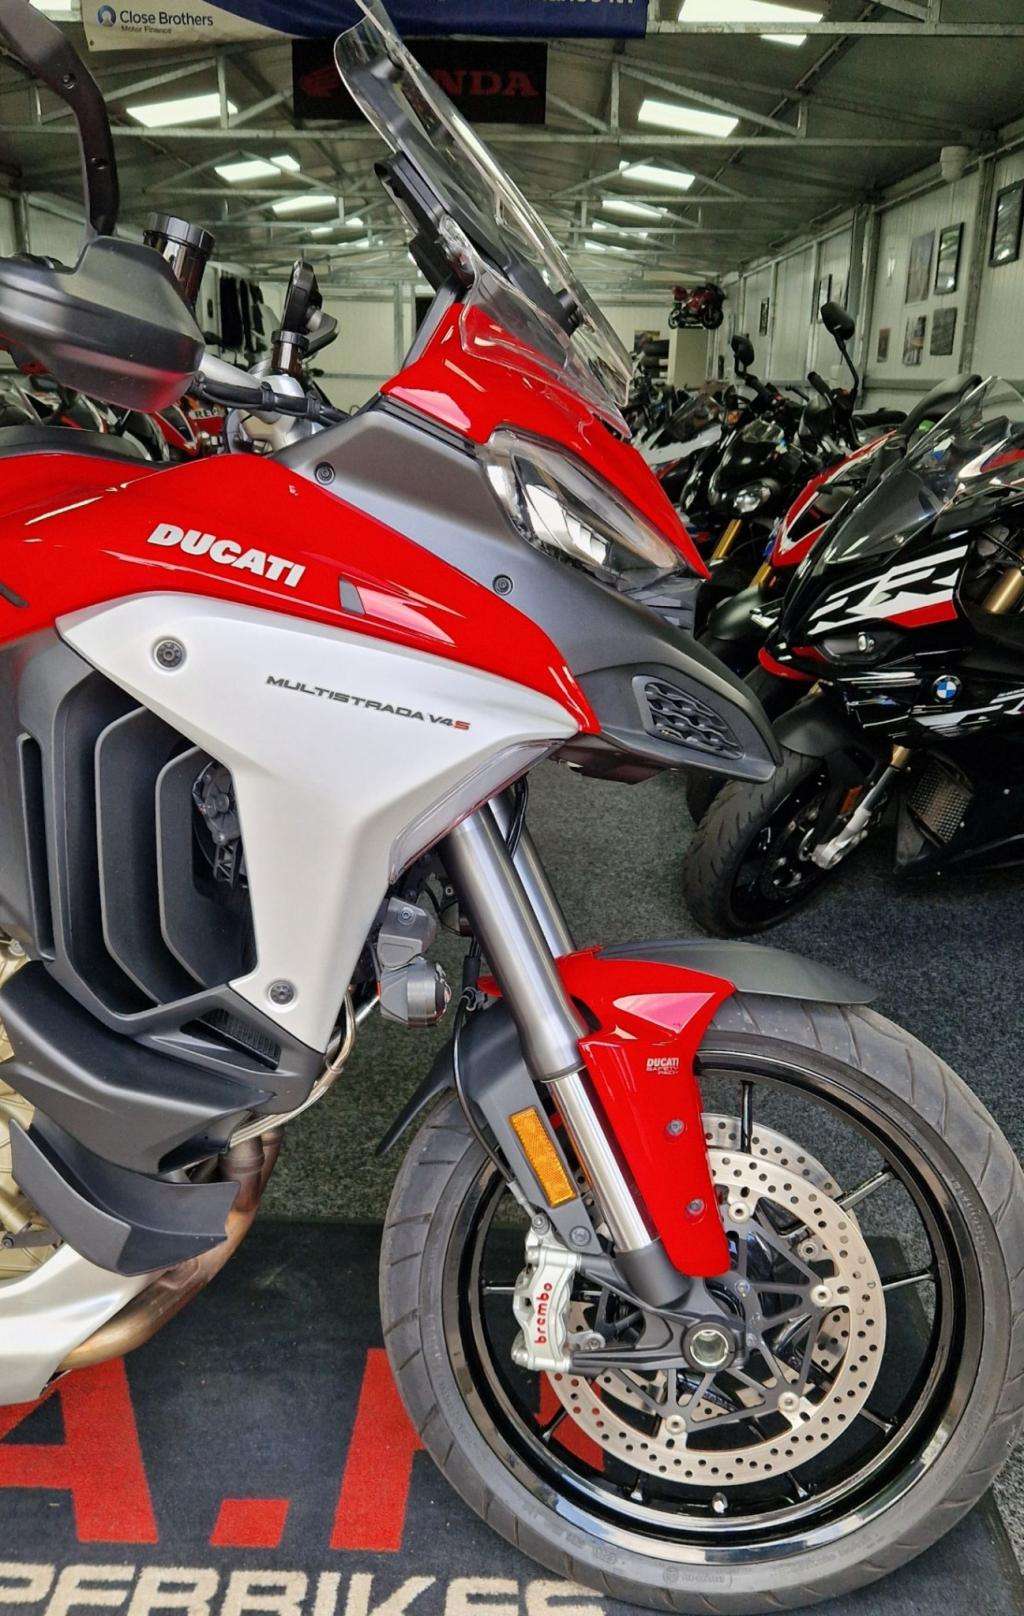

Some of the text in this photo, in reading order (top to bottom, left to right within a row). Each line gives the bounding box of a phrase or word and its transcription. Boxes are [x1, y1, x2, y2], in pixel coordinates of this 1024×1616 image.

[120, 10, 214, 26] Close Brothers
[147, 523, 306, 588] DUCATI
[266, 675, 471, 731] MULTISTRADA V4S
[646, 1058, 680, 1067] DUCATI
[534, 1282, 553, 1345] brembo
